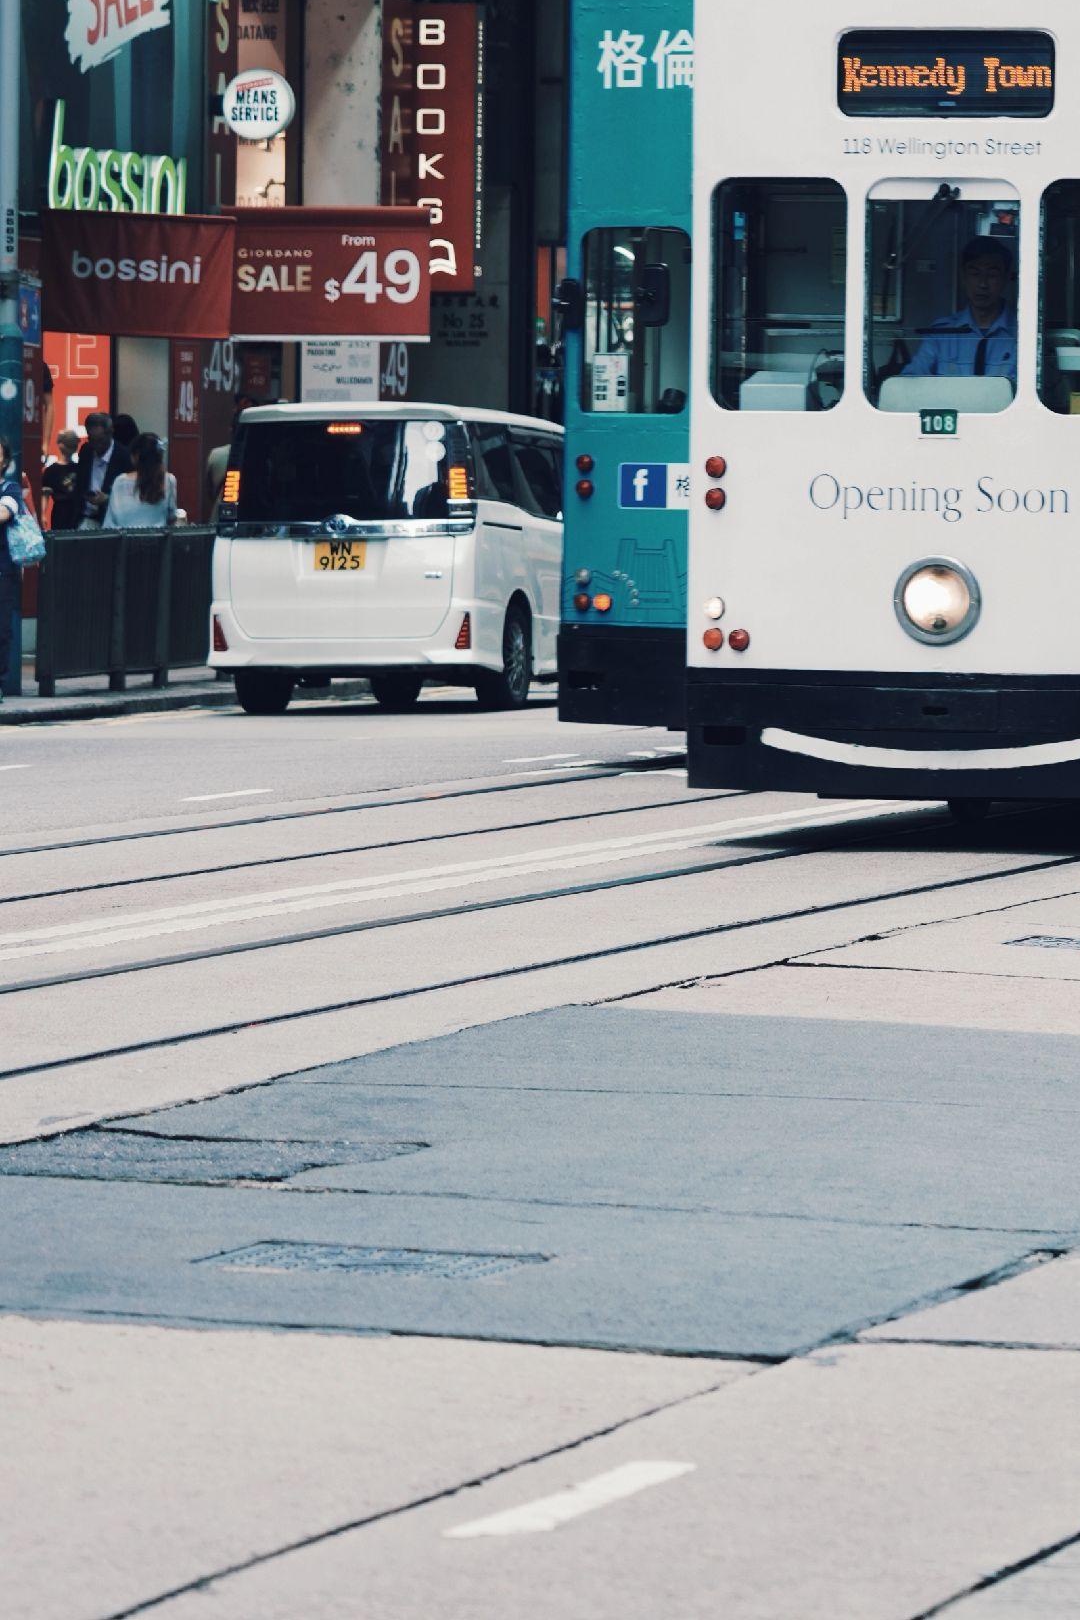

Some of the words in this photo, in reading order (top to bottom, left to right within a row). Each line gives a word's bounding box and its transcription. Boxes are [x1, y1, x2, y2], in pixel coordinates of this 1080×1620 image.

[842, 56, 966, 95] Kennedy
[983, 57, 1053, 92] Town
[236, 90, 278, 105] MEANS
[231, 107, 279, 121] SERVICE
[48, 98, 188, 215] bossini
[842, 137, 873, 156] 118
[877, 137, 980, 160] Wellington
[985, 137, 1042, 156] Street
[341, 234, 376, 247] From
[237, 248, 314, 259] GIORDANO
[72, 250, 202, 284] bossini
[237, 264, 313, 293] SALE
[324, 249, 421, 305] $49
[922, 414, 955, 432] 108
[809, 473, 963, 522] Opening
[976, 476, 1071, 514] Soon
[329, 540, 353, 556] WN
[319, 556, 360, 571] 9125
